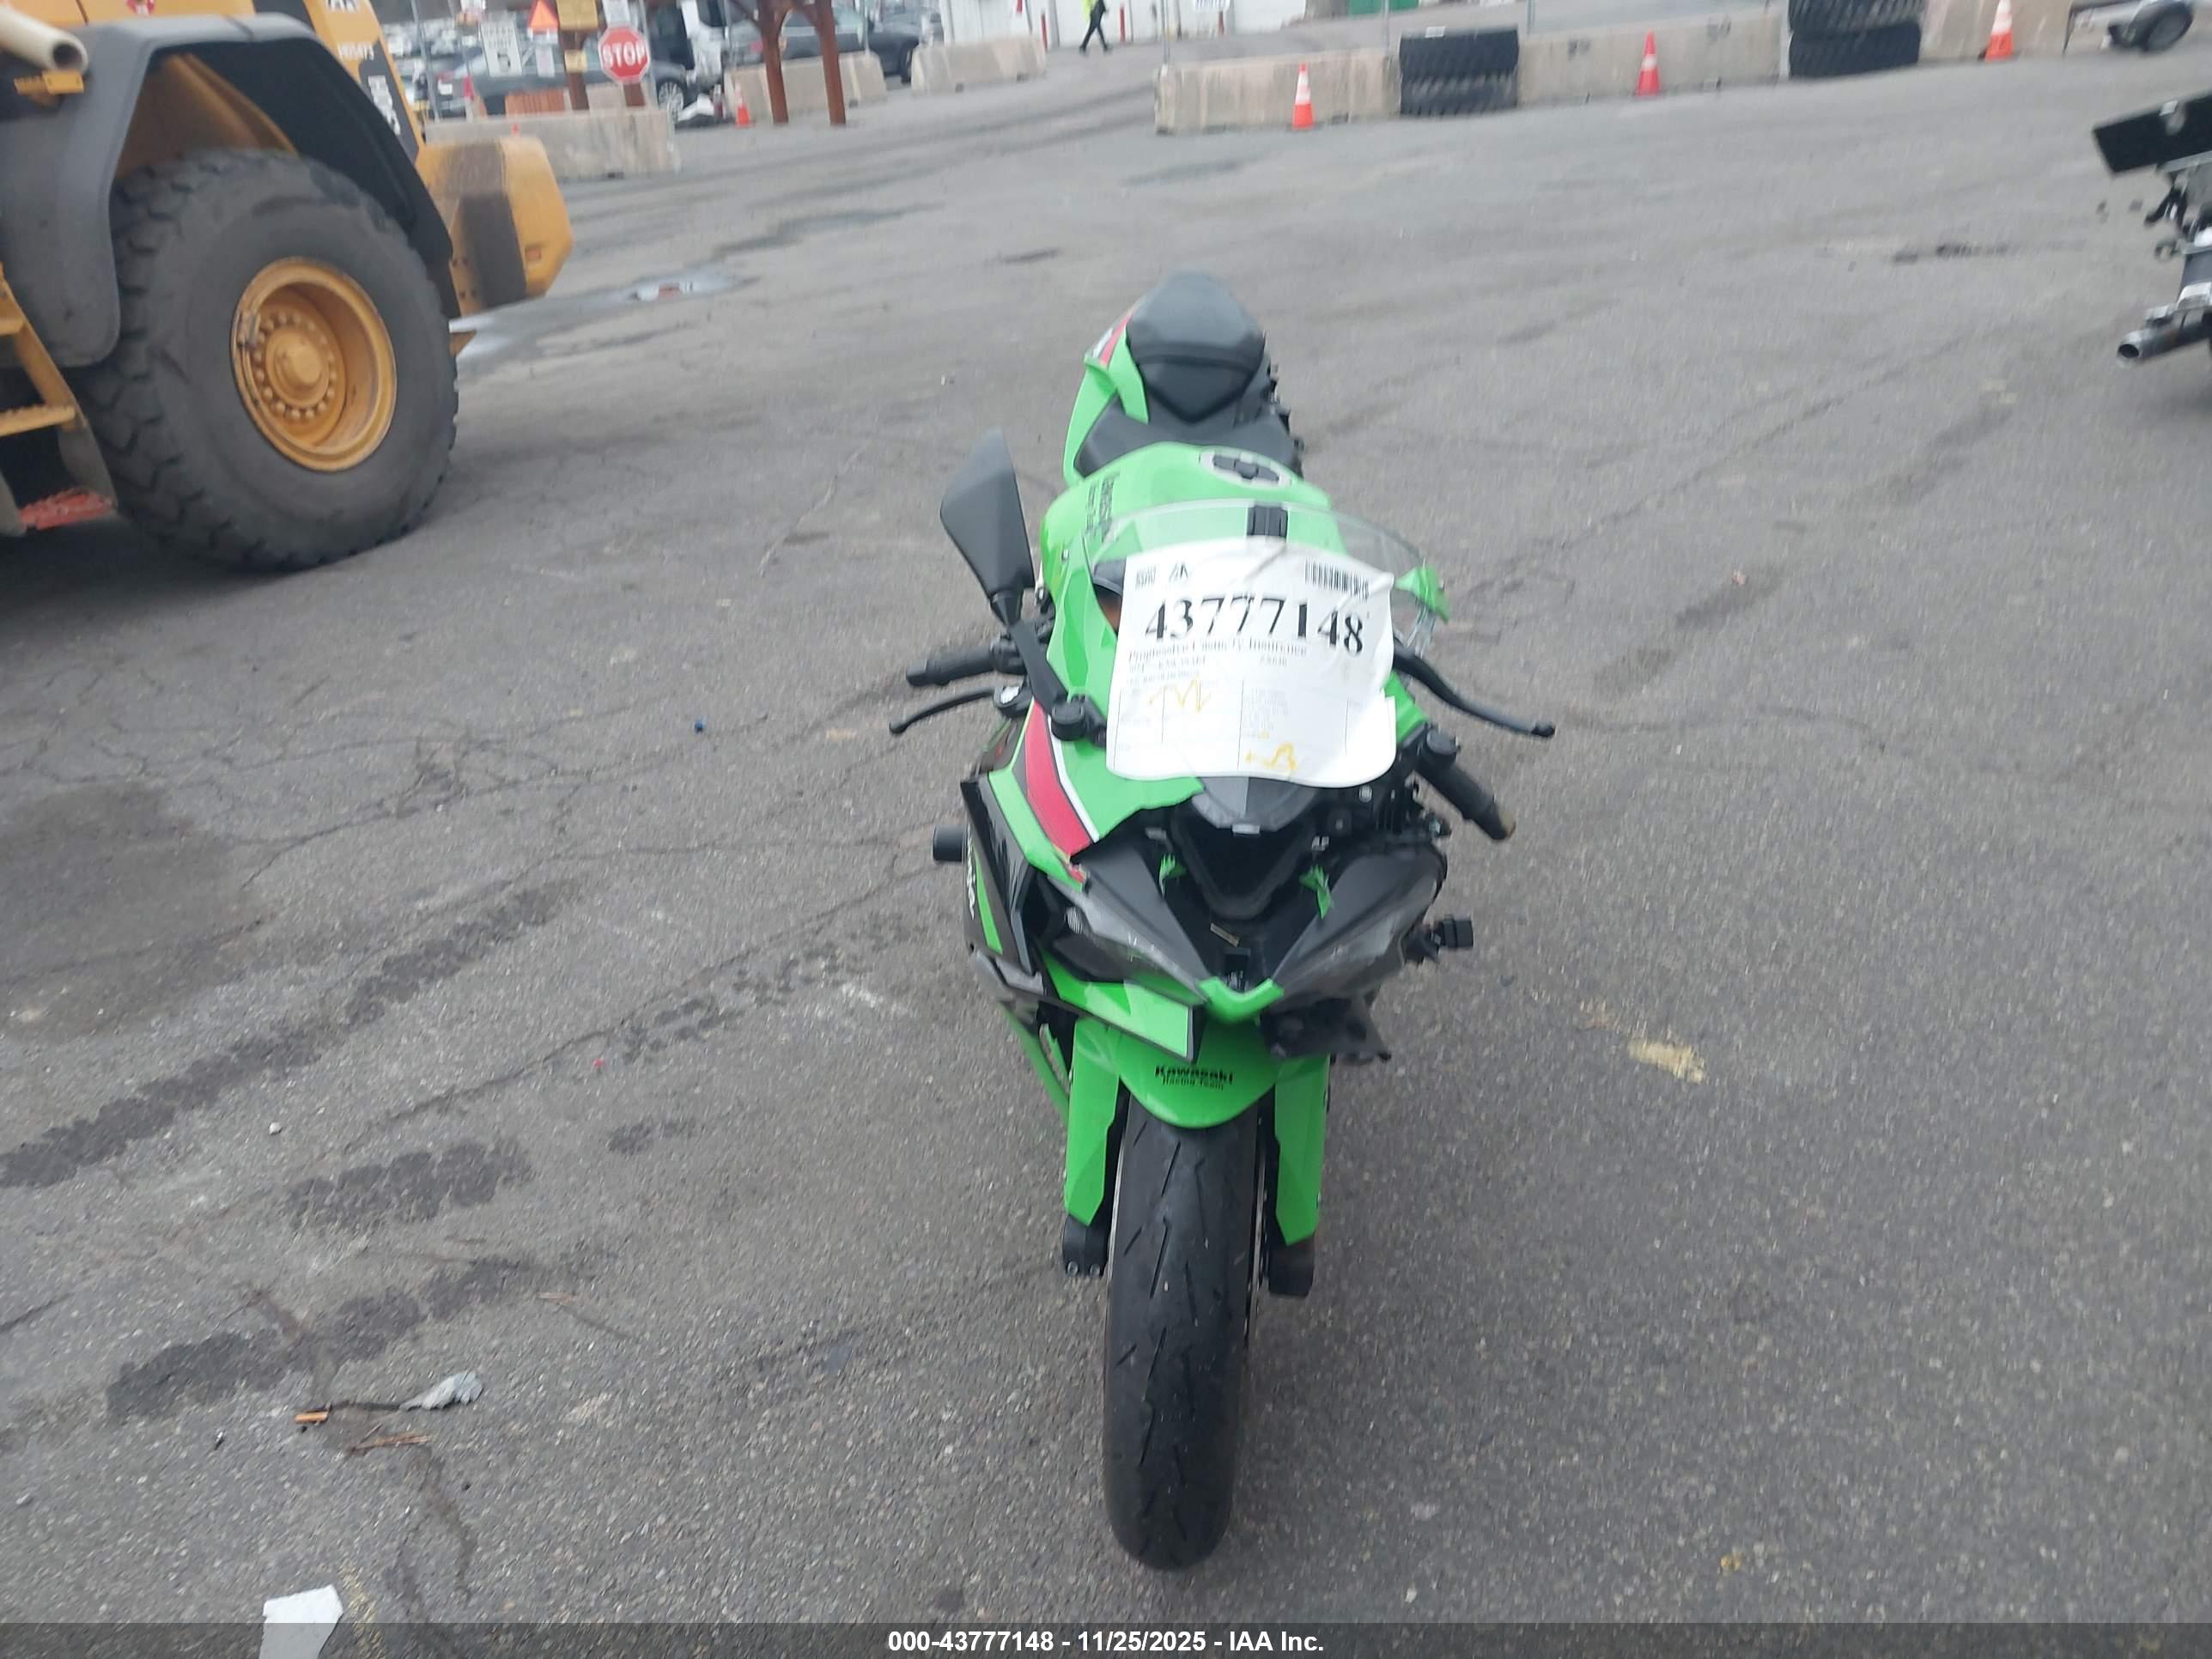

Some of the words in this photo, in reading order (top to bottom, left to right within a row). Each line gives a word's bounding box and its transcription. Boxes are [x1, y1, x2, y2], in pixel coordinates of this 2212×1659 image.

[603, 41, 646, 69] STOP
[1146, 594, 1364, 656] 43777148
[1155, 1066, 1234, 1085] Kawasaki
